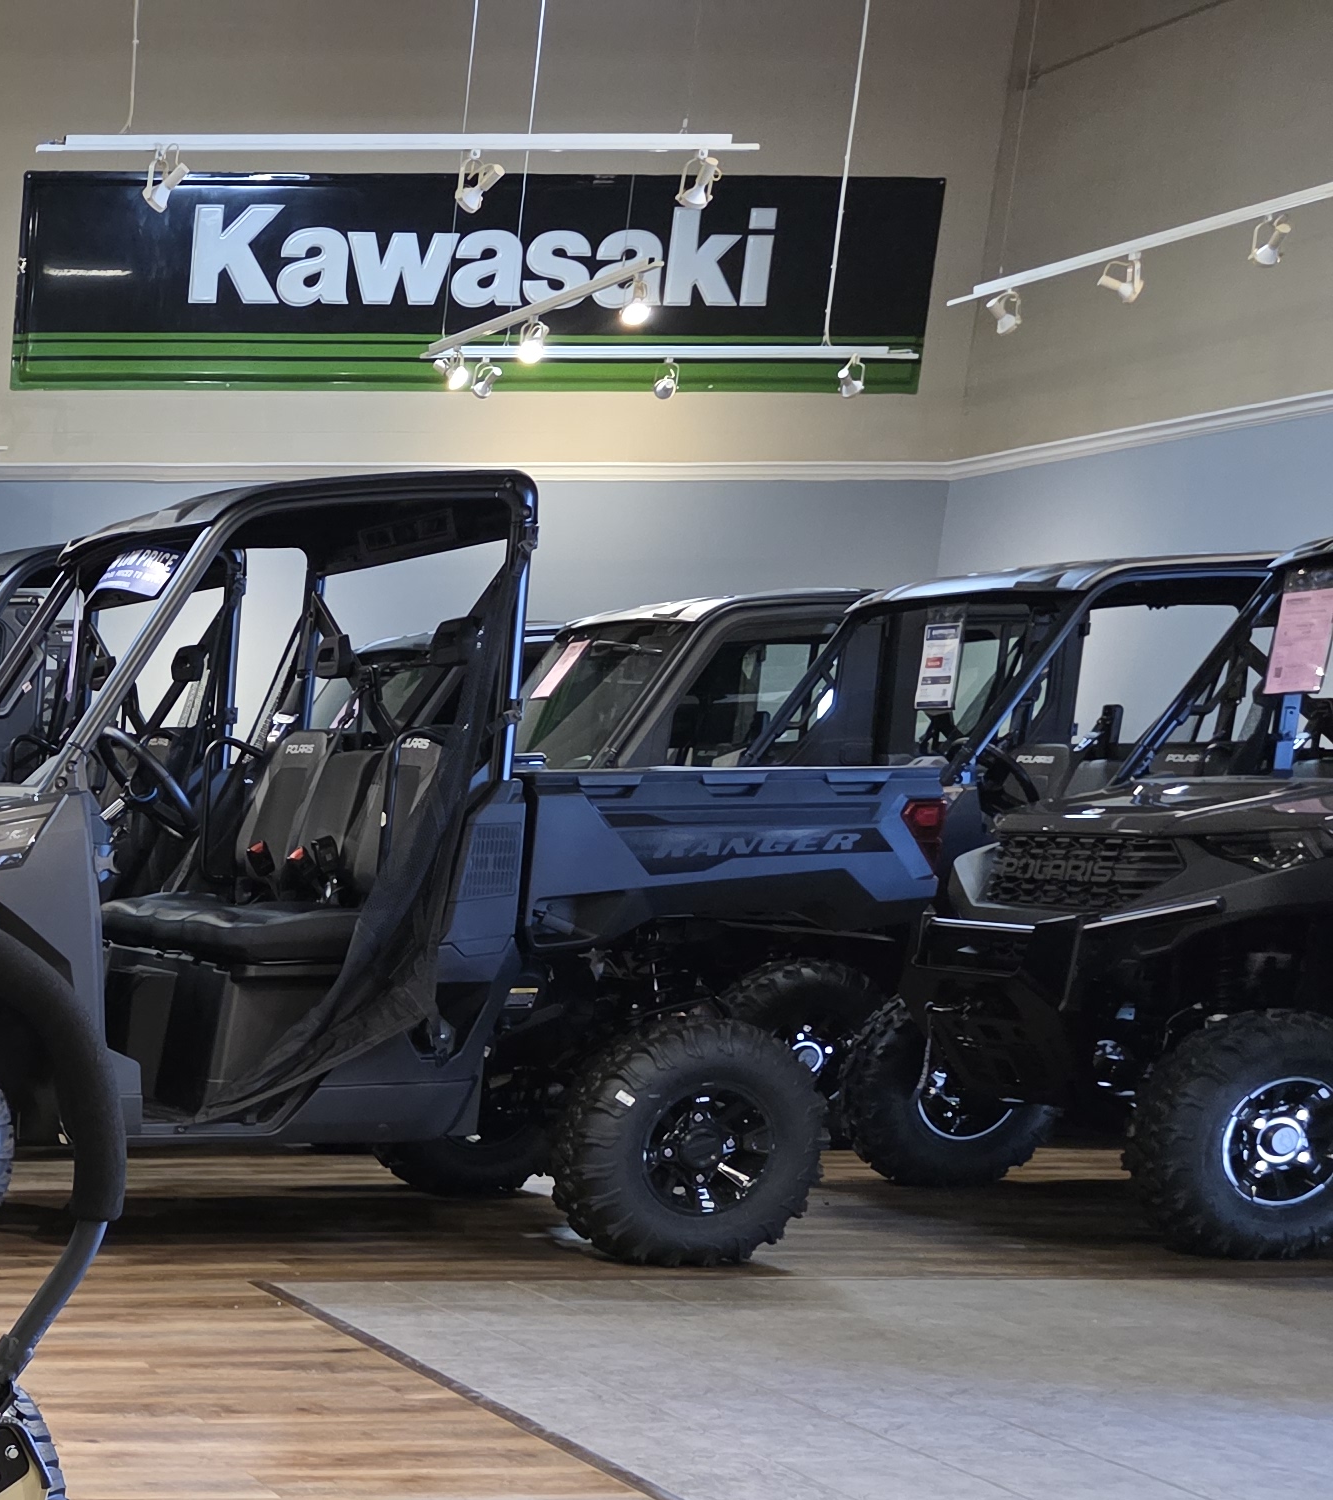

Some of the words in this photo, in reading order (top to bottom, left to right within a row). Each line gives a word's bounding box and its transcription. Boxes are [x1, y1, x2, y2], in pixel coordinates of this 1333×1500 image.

[187, 204, 778, 308] Kawasaki
[1015, 755, 1055, 765] POLARIS
[1165, 753, 1210, 764] POLARS
[652, 832, 862, 859] RANGER
[1002, 857, 1115, 884] POLARIS
